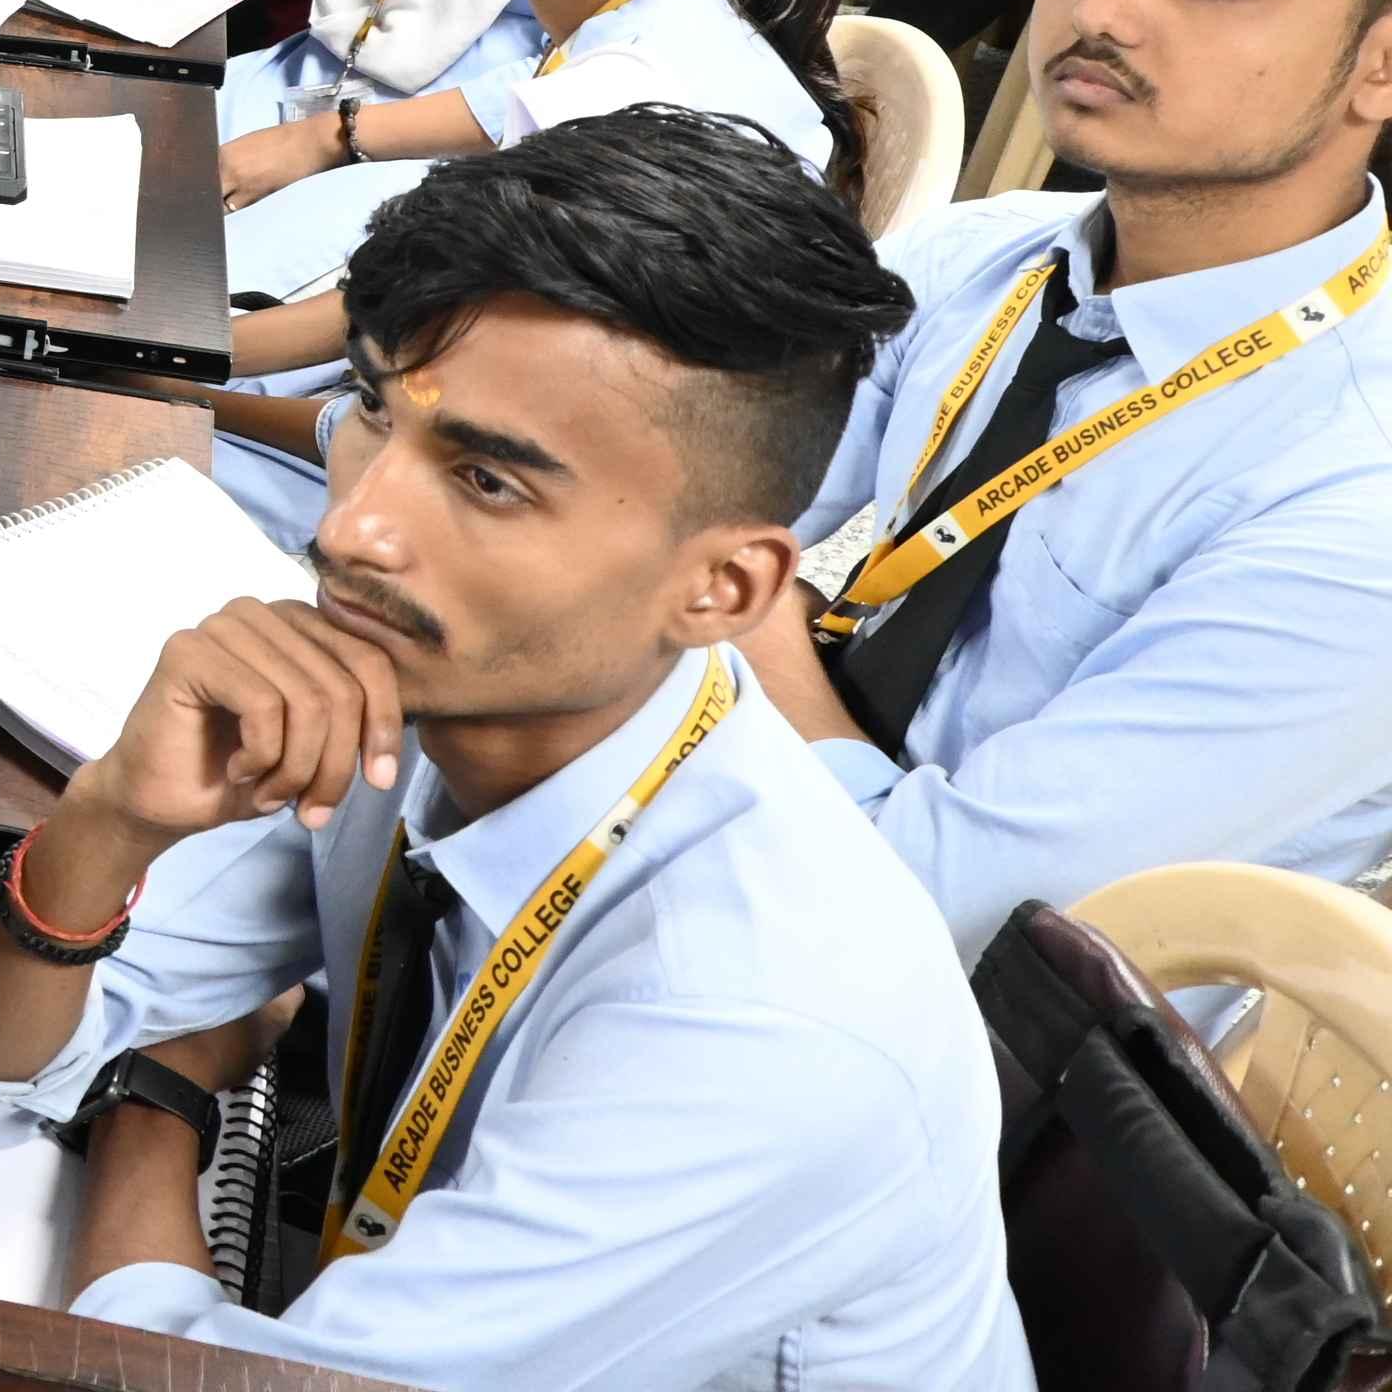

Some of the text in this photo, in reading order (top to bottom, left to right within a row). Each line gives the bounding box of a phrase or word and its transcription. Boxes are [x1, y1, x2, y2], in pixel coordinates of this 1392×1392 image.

[949, 305, 1017, 399] BUSINESS
[975, 329, 1273, 518] ARCADE BUSINESS COLLEGE
[382, 872, 583, 1194] ARCADE BUSINESS COLLEGE
